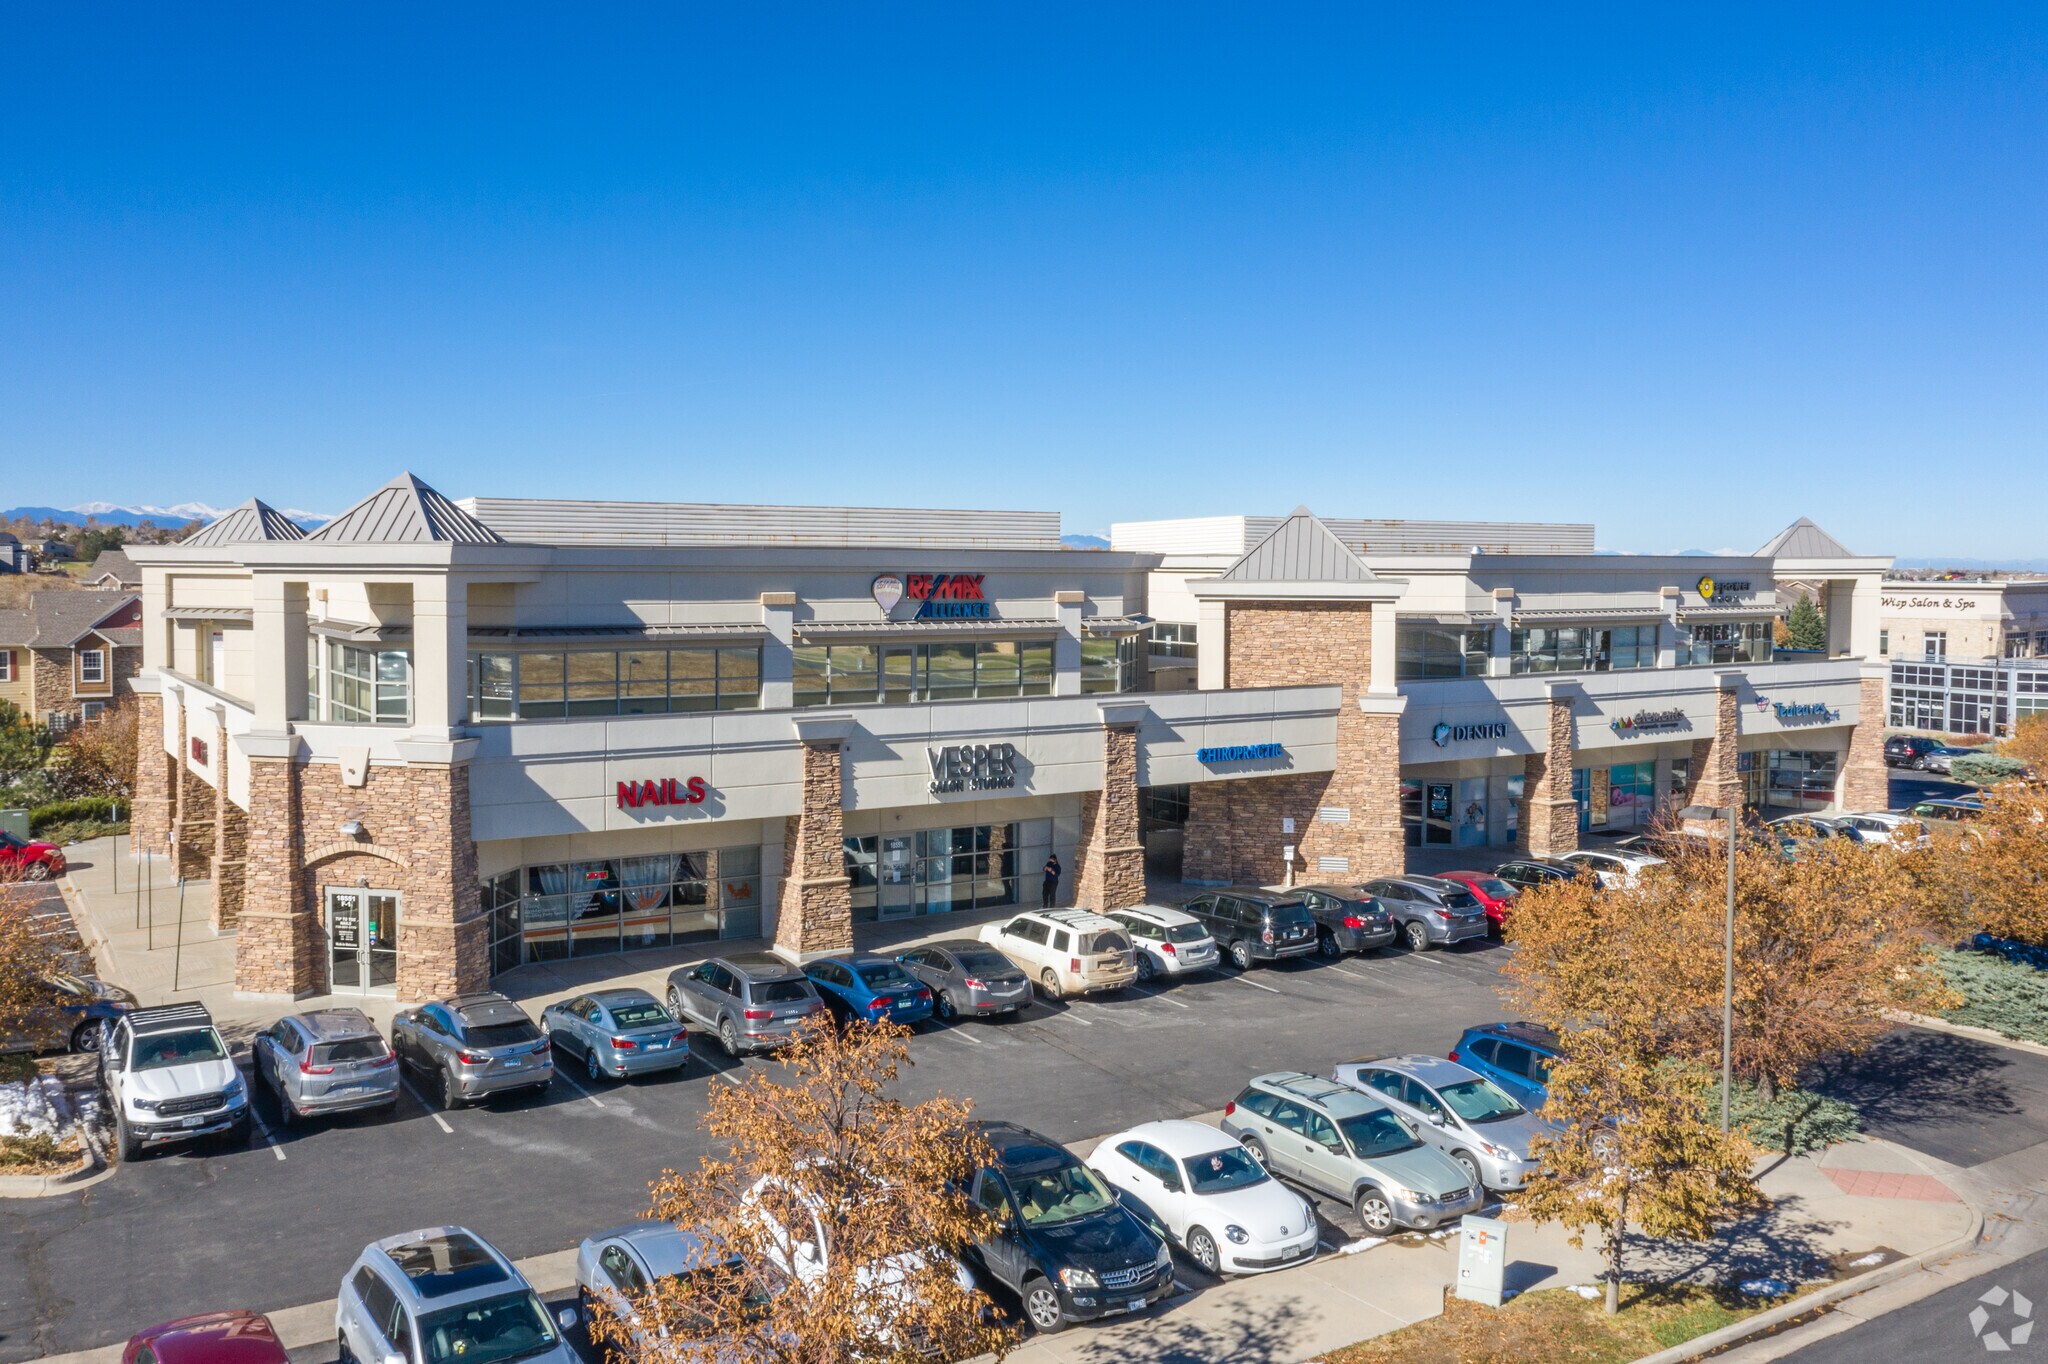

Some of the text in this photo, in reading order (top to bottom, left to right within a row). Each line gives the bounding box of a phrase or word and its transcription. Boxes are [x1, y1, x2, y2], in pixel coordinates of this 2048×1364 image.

[906, 574, 985, 600] RE/MAX
[913, 600, 990, 620] ALLIANCE
[1881, 597, 1976, 612] Wisp Salon & Spa
[1737, 623, 1771, 640] YOGA
[1635, 707, 1684, 722] elements
[1772, 701, 1826, 717] Tealeaves
[1454, 723, 1509, 741] DENTIST
[925, 742, 1017, 780] VESPER
[1197, 742, 1284, 763] CHIROPRACTIC
[616, 776, 706, 809] NAILS
[927, 775, 1016, 794] SALON STUDIOS
